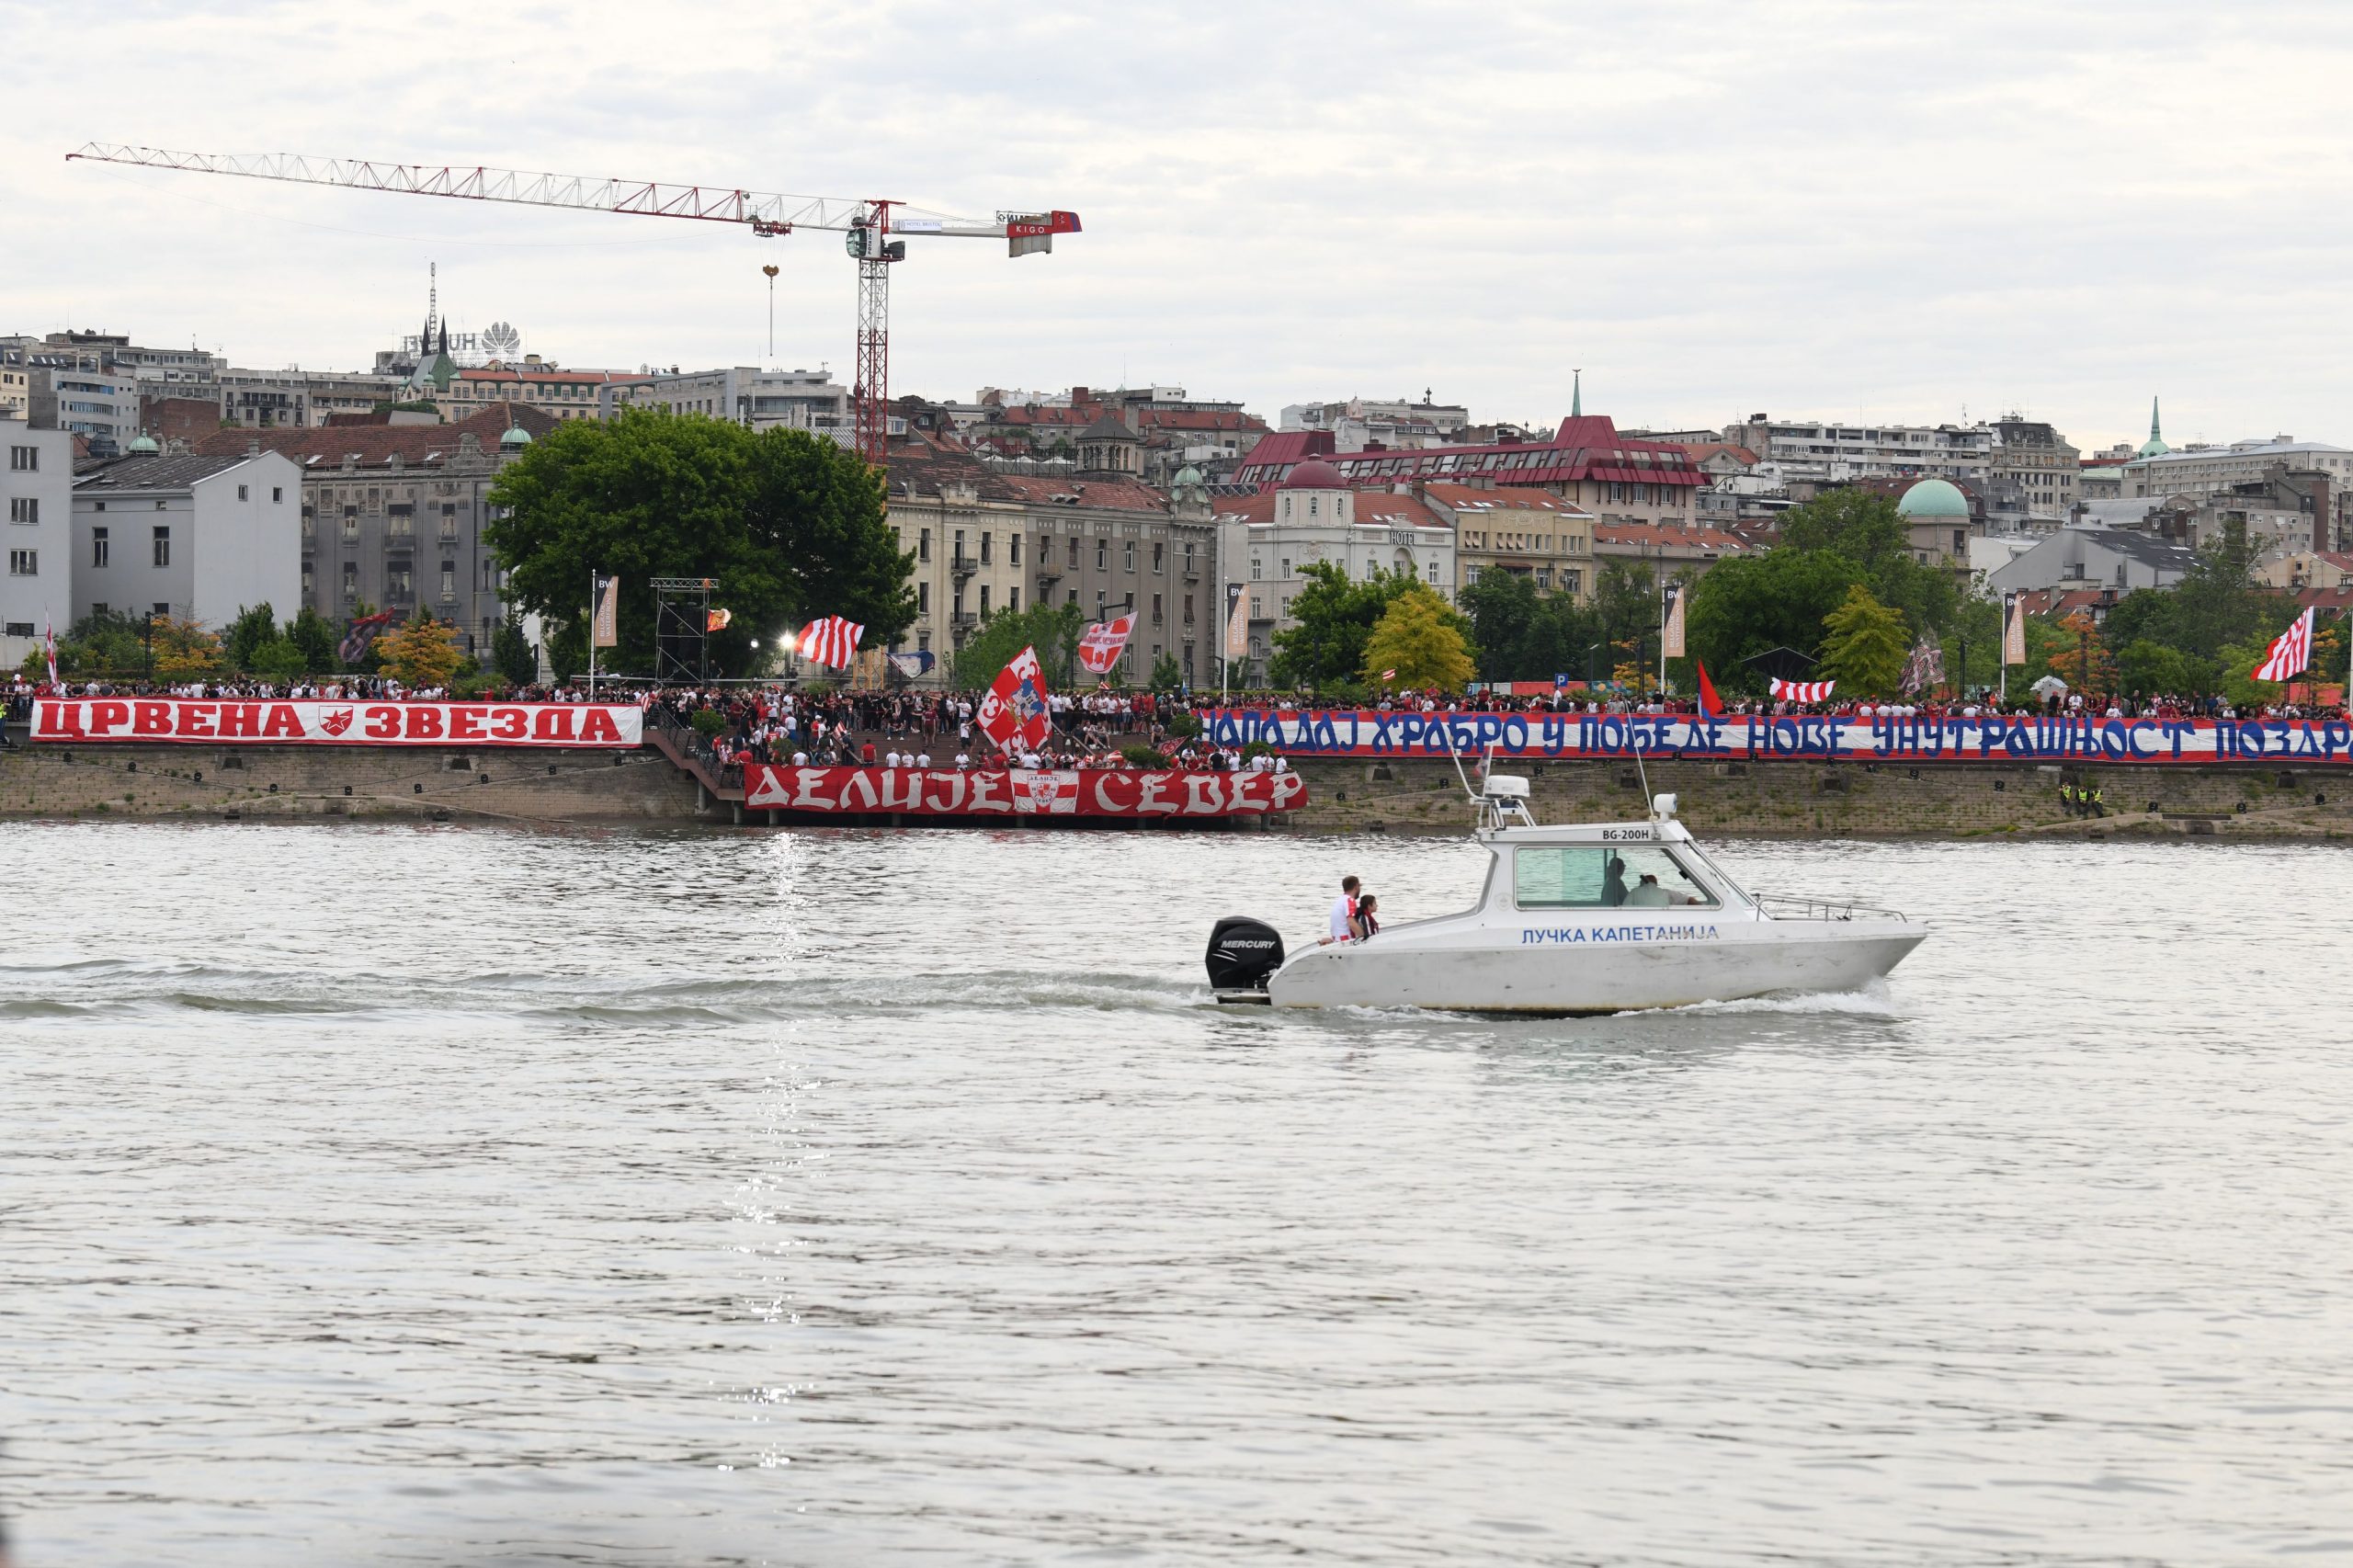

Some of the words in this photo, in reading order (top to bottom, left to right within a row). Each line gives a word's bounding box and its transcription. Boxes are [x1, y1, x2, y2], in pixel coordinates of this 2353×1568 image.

[1391, 531, 1416, 545] HOTEL
[599, 580, 615, 588] BW
[1231, 588, 1246, 597] BW
[1667, 591, 1682, 599] BW
[2007, 598, 2020, 607] BW
[38, 701, 306, 741] ЦРВЕНА
[365, 706, 622, 742] ЗВЕЗДА
[1372, 711, 1529, 755] ХРАБРО
[1541, 715, 1567, 756] У
[1579, 715, 1732, 755] ПОБЕДЕ
[1747, 715, 1856, 756] НОВЕ
[1871, 715, 2196, 761] УНУТРАШЊОСТ
[2215, 719, 2353, 760] ПОЗДР
[747, 766, 1014, 812] ДЕЛИЈЕ
[1095, 769, 1303, 815] СЕВЕР
[1603, 829, 1649, 839] BG-200H
[1521, 928, 1586, 944] ЛУЧКА
[1592, 925, 1720, 942] КАПЕТАНИЈА
[1221, 939, 1276, 949] MERCURY
